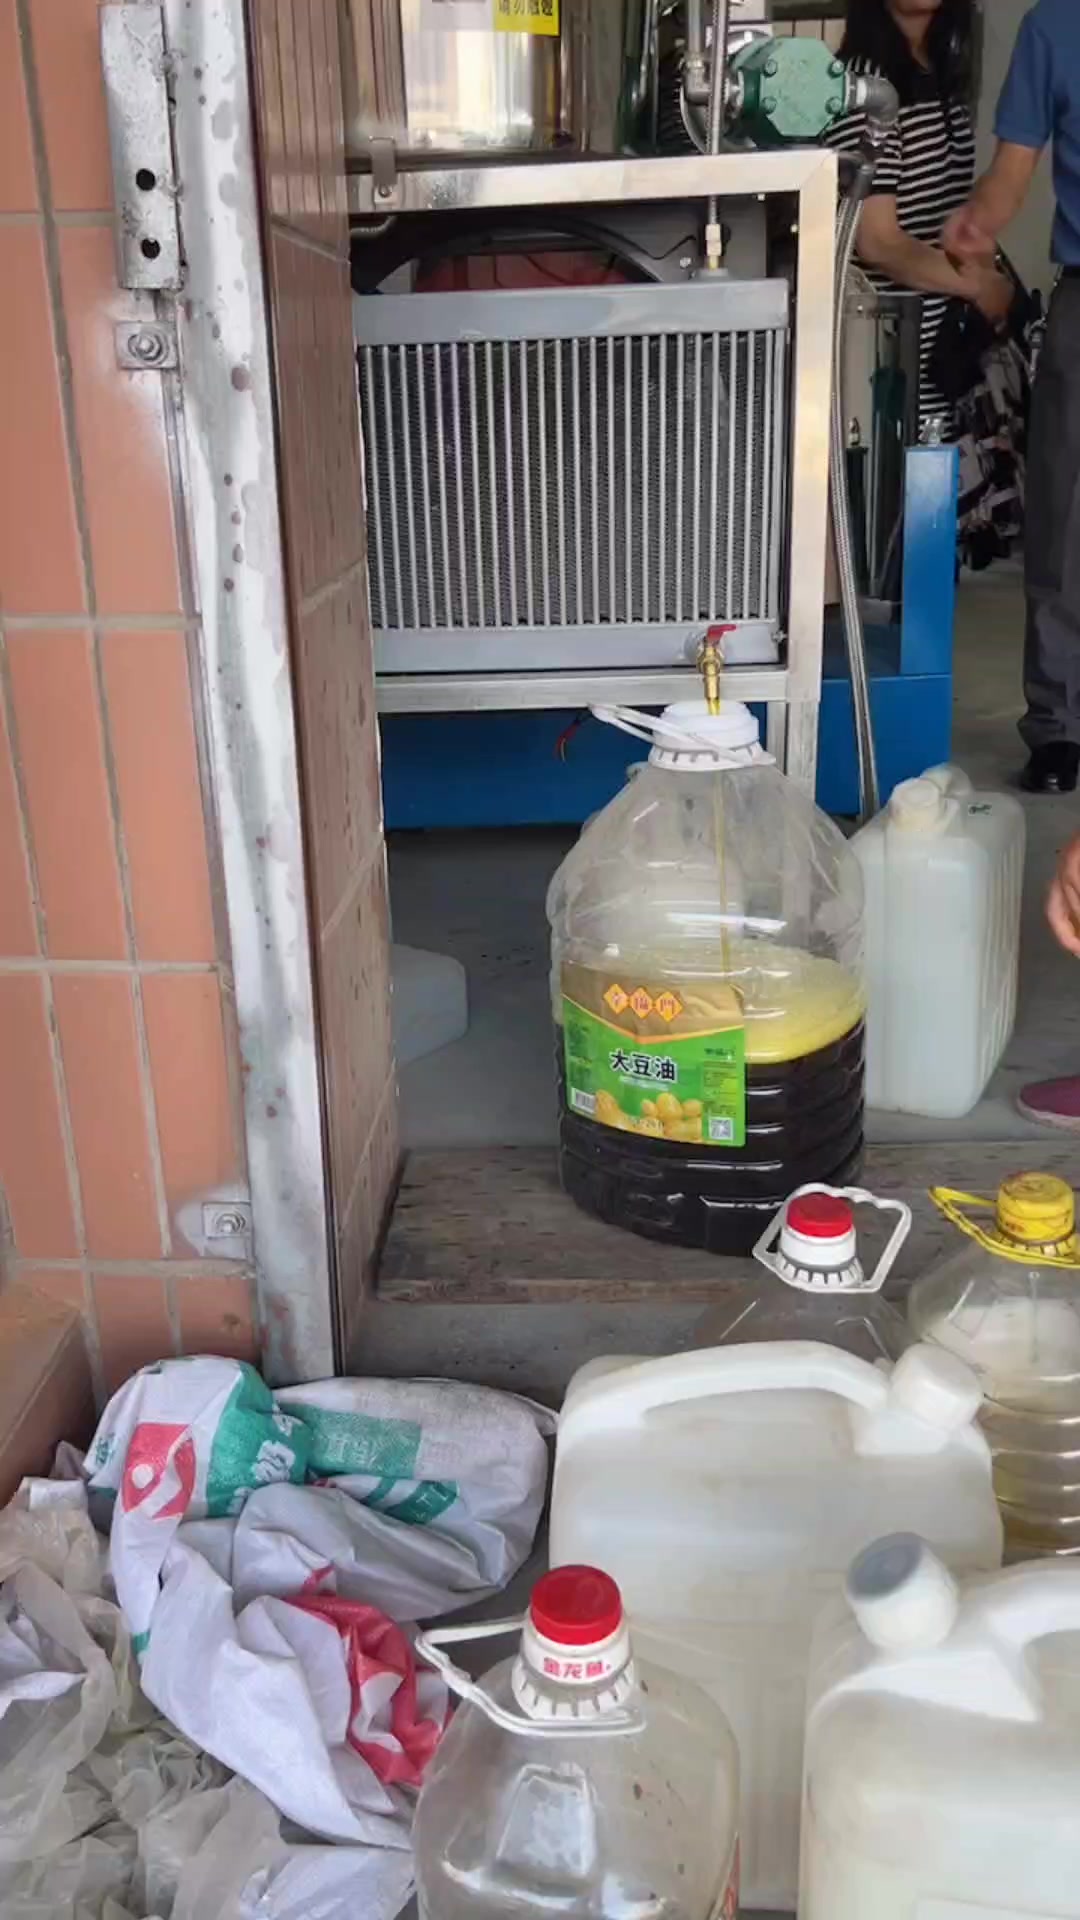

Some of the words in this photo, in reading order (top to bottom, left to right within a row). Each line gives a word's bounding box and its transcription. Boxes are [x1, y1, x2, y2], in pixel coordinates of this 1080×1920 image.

[610, 1048, 677, 1081] 大豆油
[543, 1657, 603, 1679] 金龙鱼
